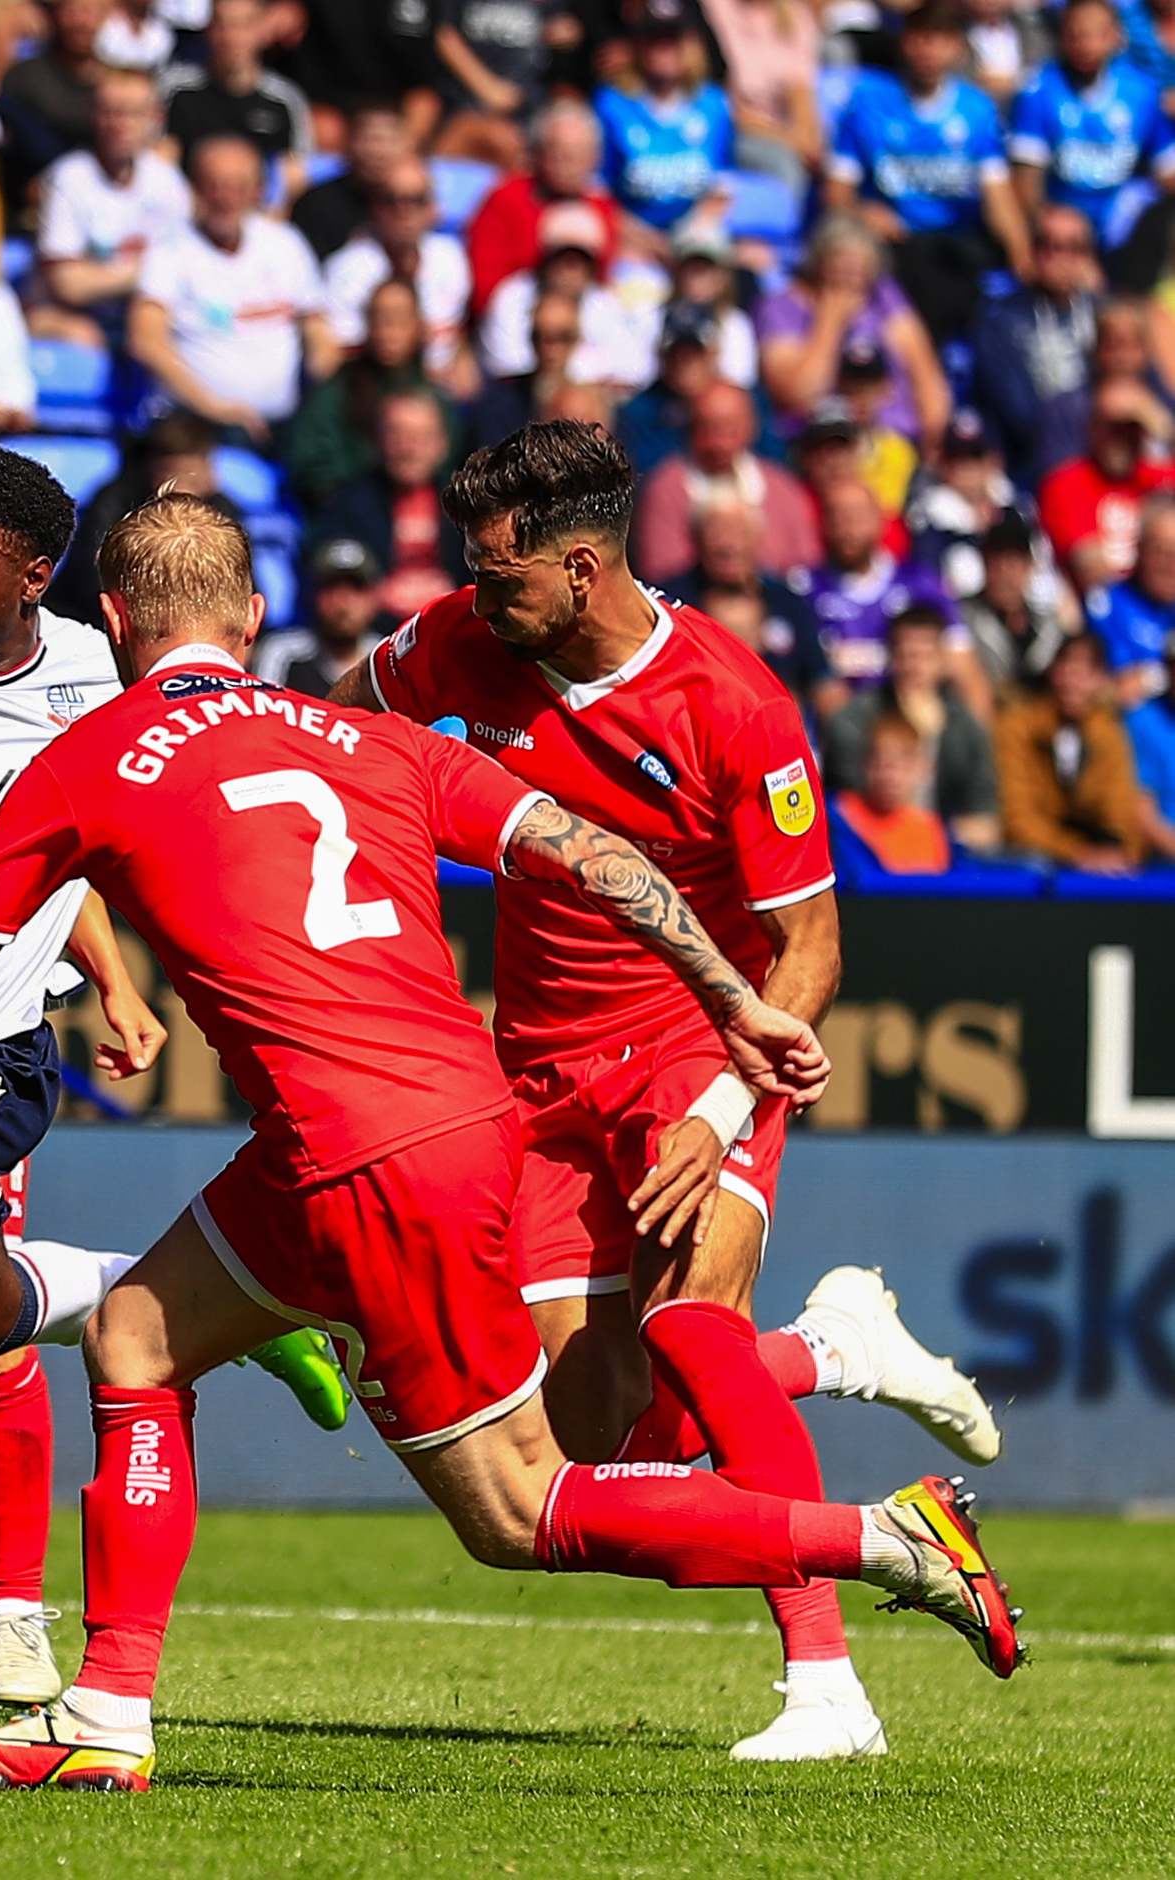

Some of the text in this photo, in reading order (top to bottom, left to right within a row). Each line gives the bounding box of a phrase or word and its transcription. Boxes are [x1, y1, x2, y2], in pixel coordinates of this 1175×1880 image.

[117, 691, 361, 784] GRIMMER
[770, 776, 786, 789] sky
[218, 769, 402, 952] 2
[1086, 945, 1175, 1140] L
